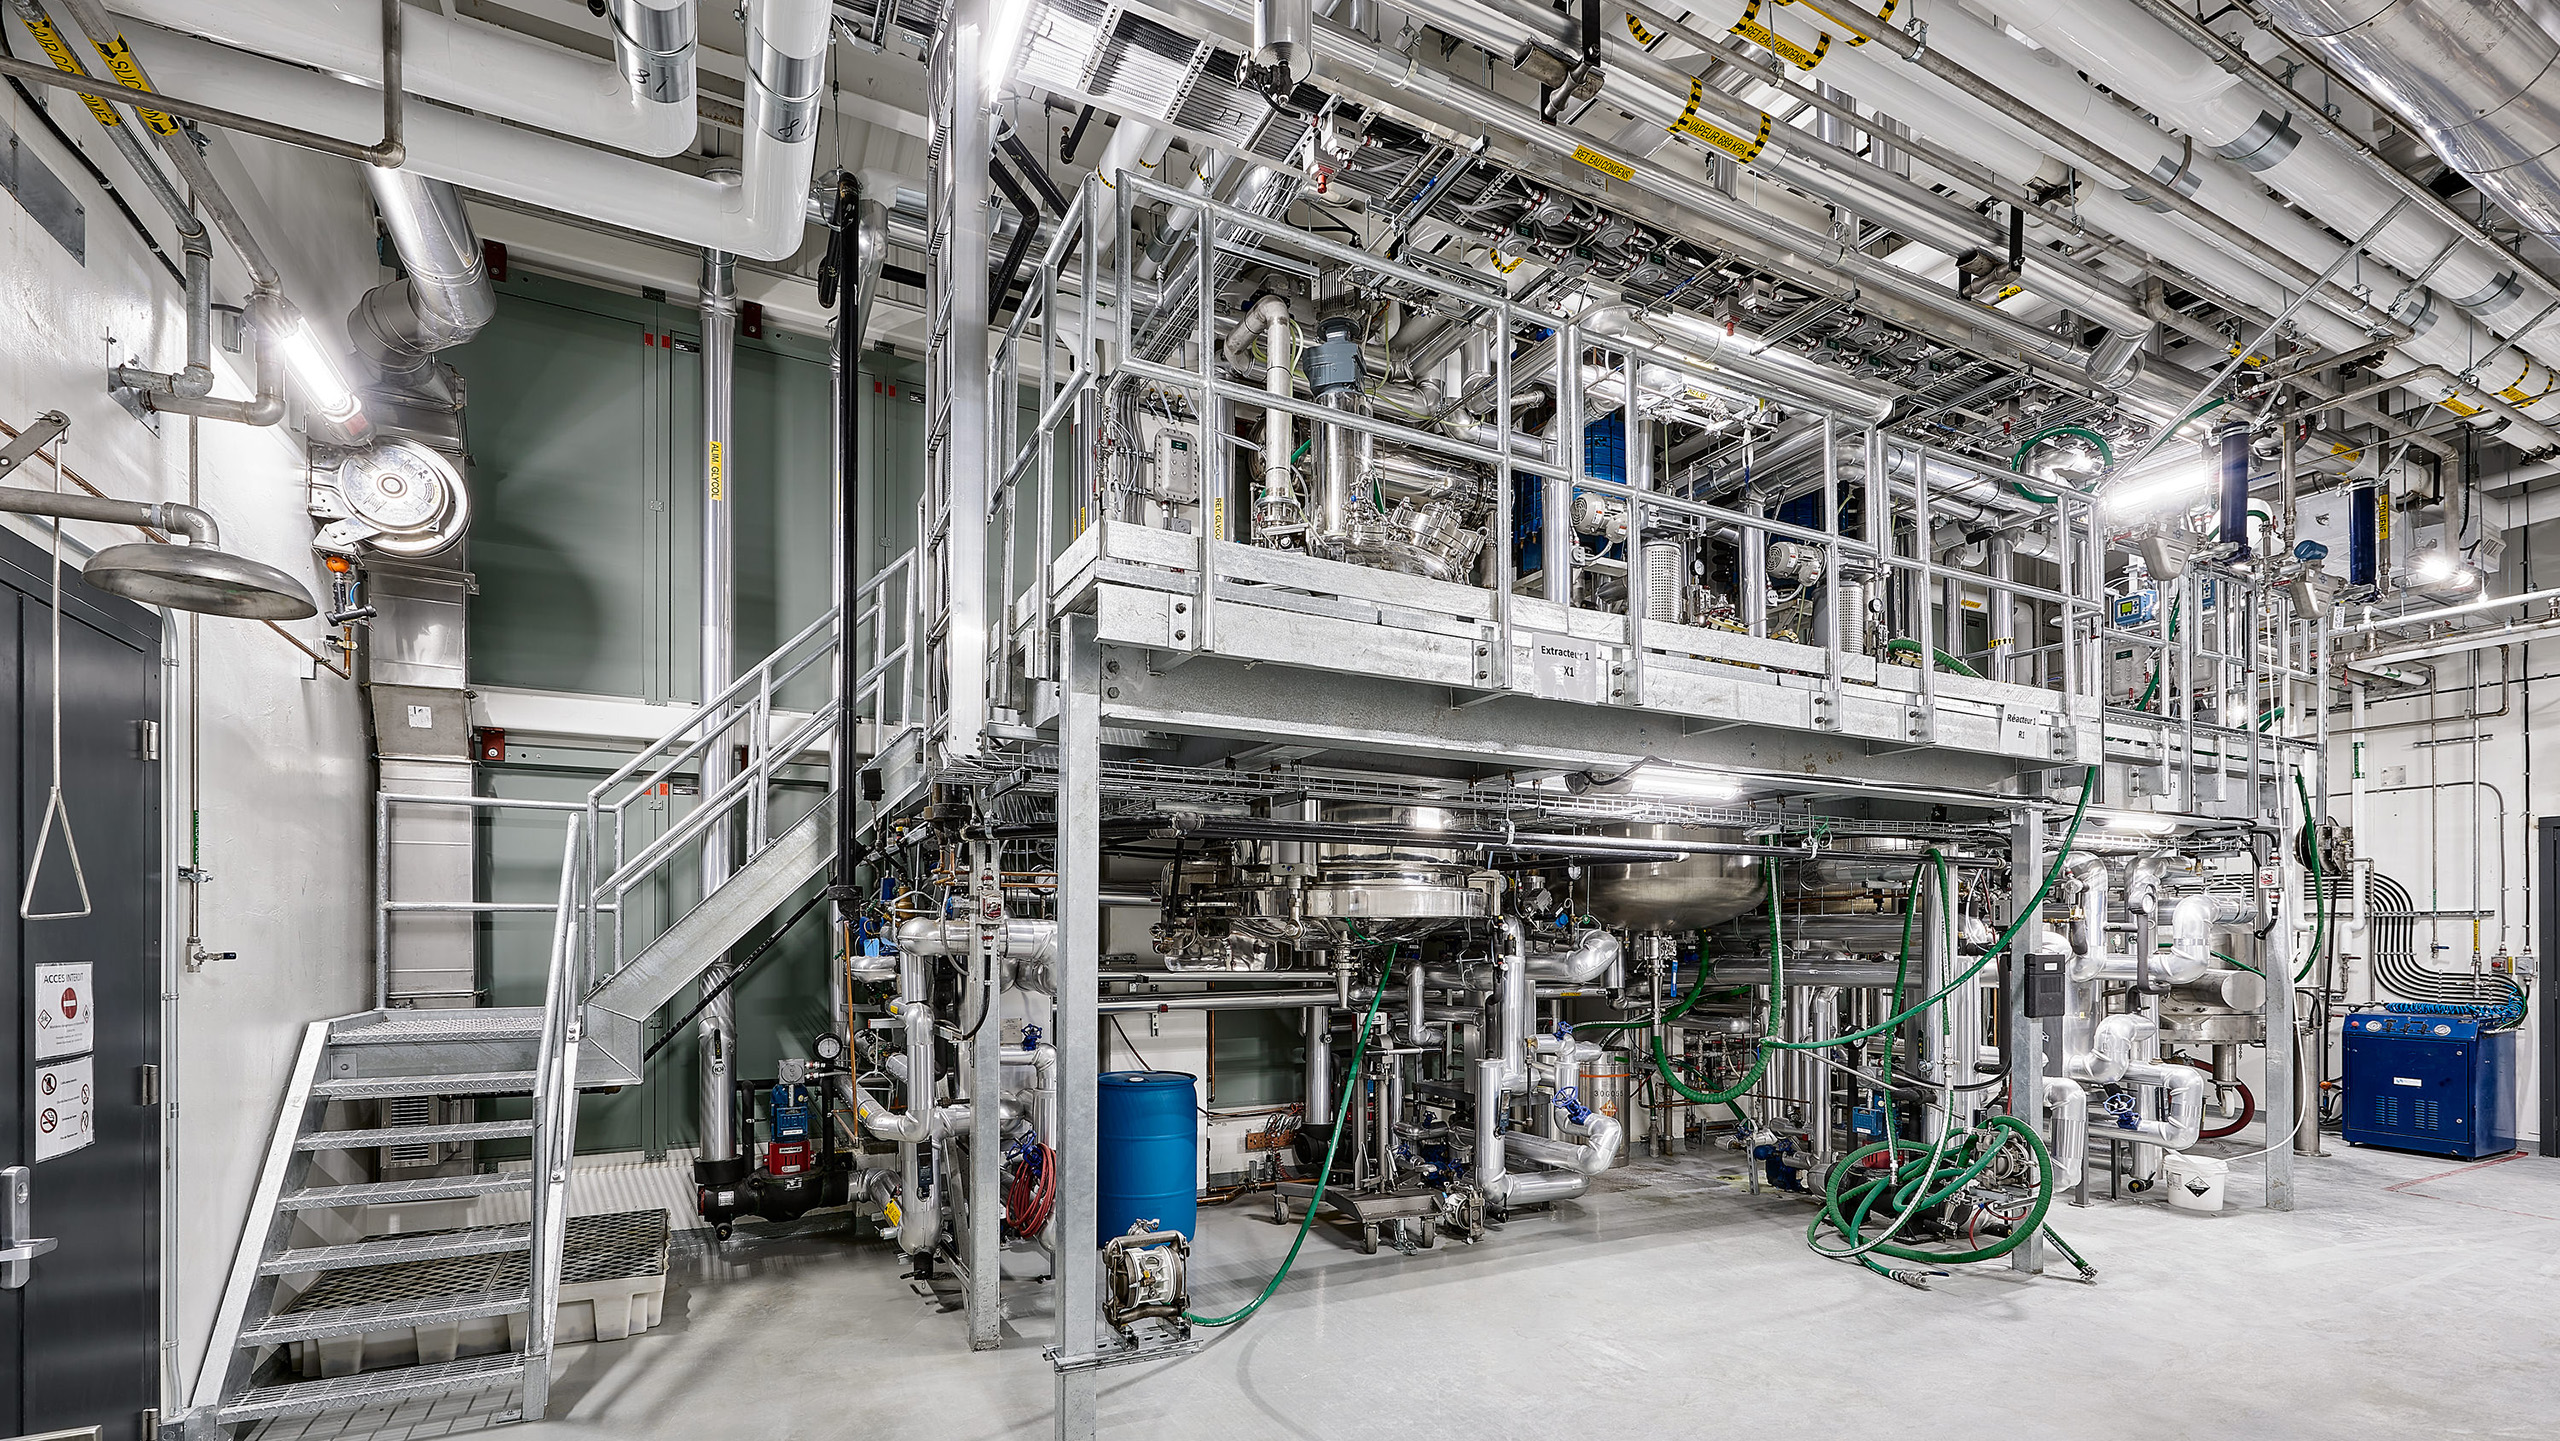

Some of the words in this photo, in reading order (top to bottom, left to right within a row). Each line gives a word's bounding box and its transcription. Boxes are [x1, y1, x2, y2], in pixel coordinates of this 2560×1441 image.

[30, 27, 60, 55] AIR
[1687, 120, 1721, 143] VAPEUR
[1730, 141, 1749, 156] KPA
[1587, 155, 1602, 169] EAU
[711, 443, 721, 464] ALIM
[711, 466, 721, 498] GLYCOL
[1214, 515, 1222, 540] GLYCO
[1541, 645, 1583, 659] Extracteur
[1584, 651, 1590, 661] 1
[1563, 665, 1575, 677] X1
[2006, 713, 2033, 725] Réacteur
[2032, 717, 2037, 726] 1
[2018, 730, 2025, 739] R1
